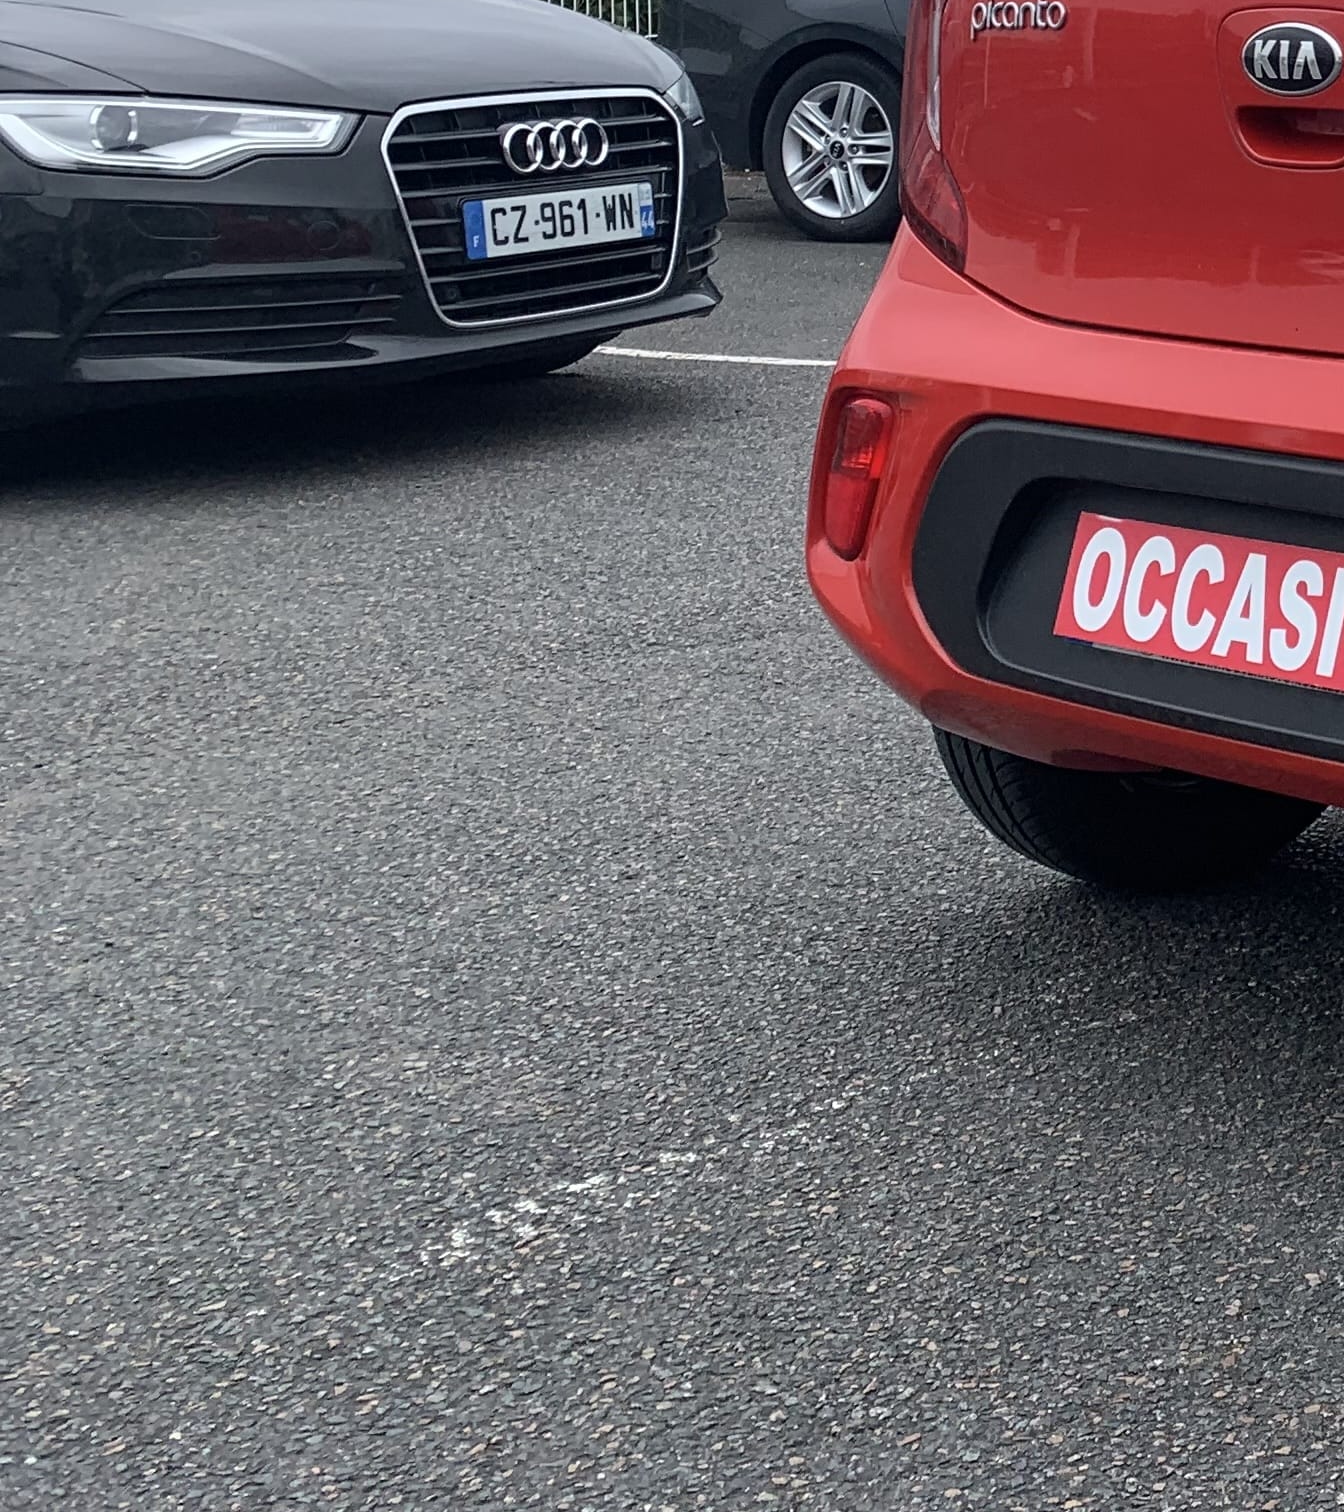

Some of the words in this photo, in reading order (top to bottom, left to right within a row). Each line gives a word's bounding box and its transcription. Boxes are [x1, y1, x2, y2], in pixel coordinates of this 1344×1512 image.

[1252, 38, 1322, 81] KIA
[472, 234, 481, 248] F
[642, 210, 655, 230] 44
